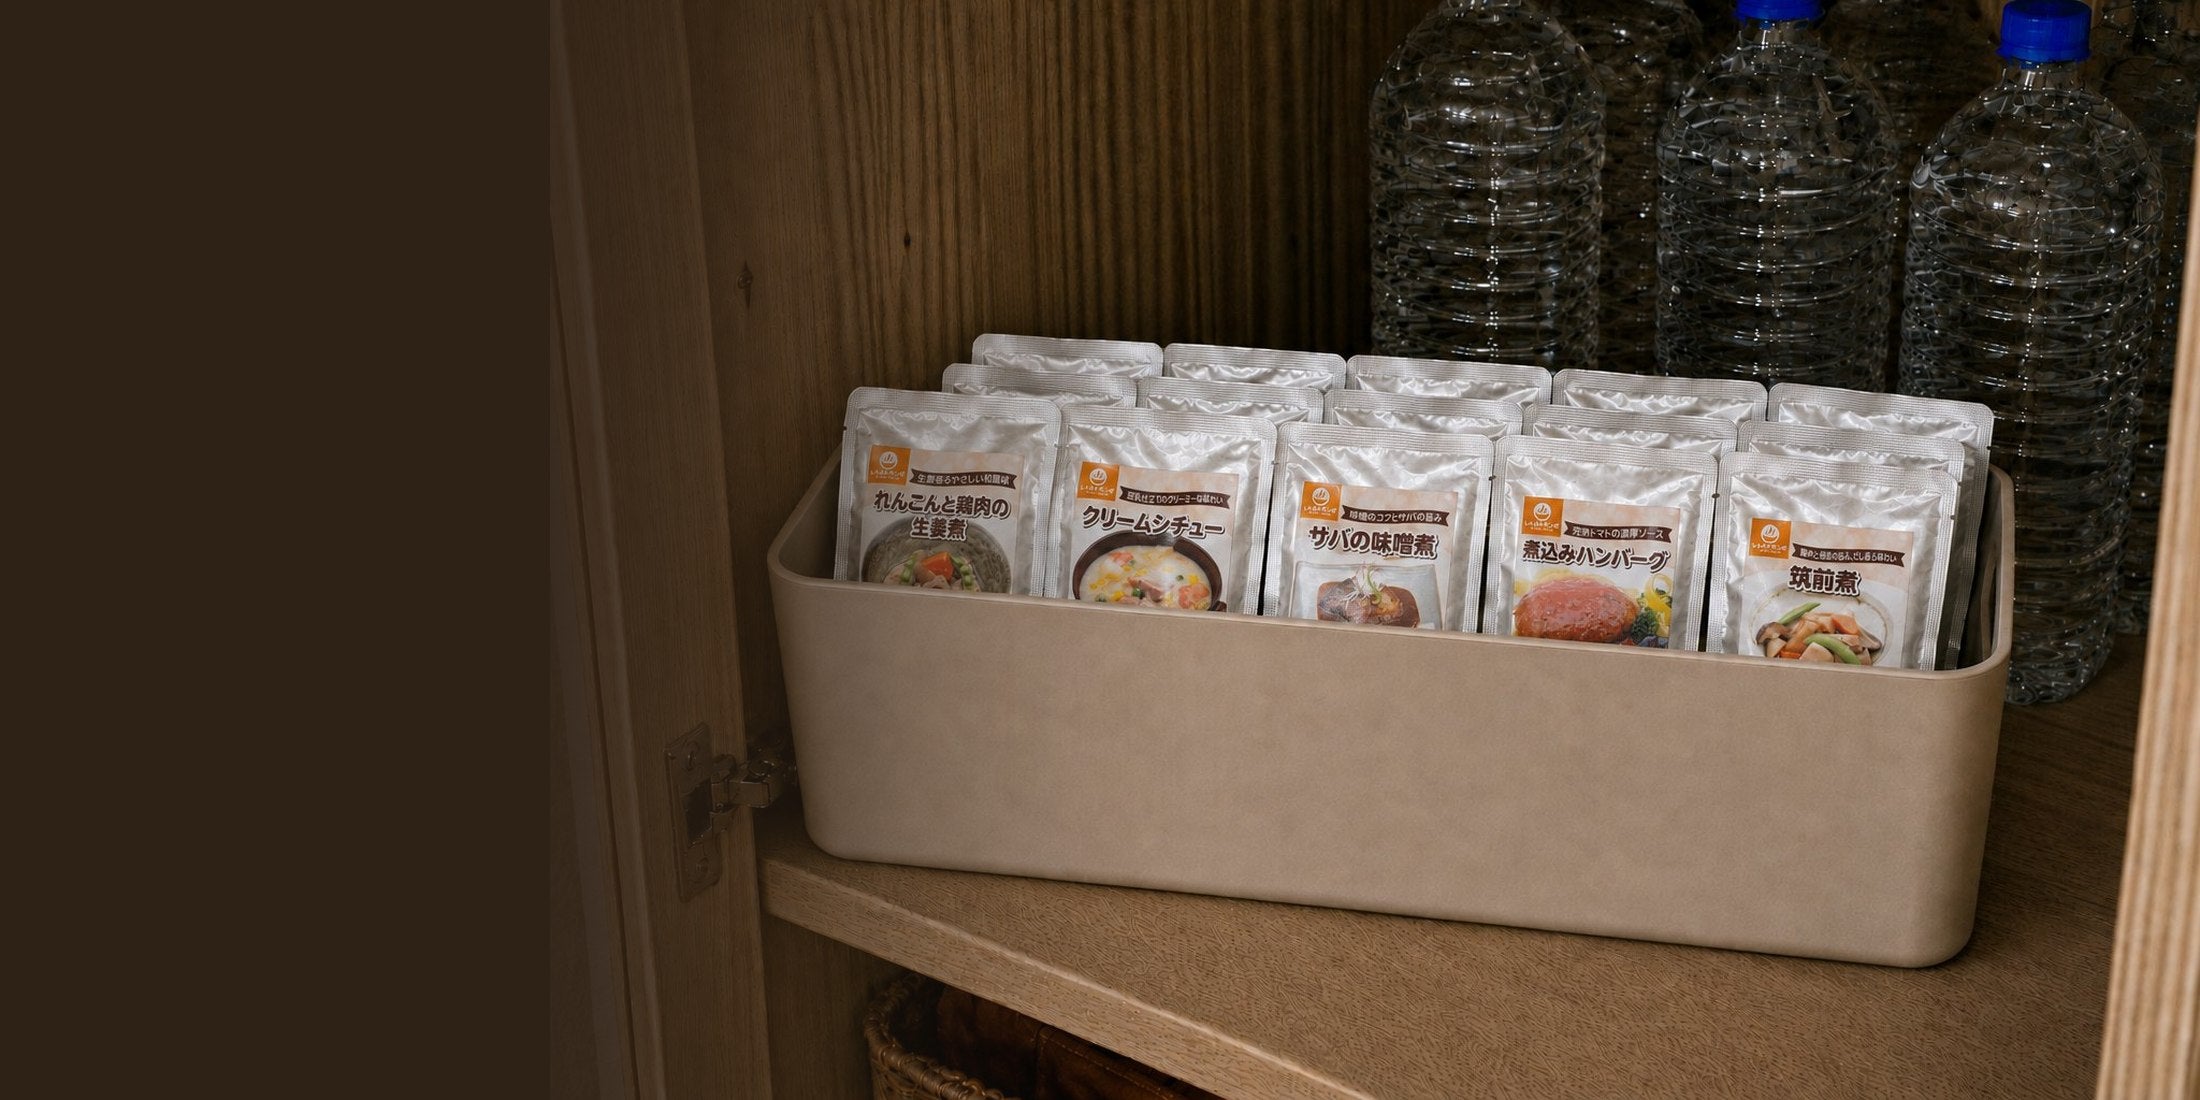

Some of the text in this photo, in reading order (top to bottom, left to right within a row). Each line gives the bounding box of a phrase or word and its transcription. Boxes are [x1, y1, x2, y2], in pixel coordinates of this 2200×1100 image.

[874, 490, 1010, 518] れんこんと鶏肉の
[911, 518, 967, 540] 生姜煮
[1083, 506, 1224, 537] クリームシチュー
[1572, 528, 1664, 539] 完熟トマトの濃厚ソース
[1309, 526, 1437, 558] サバの味噌煮
[1522, 540, 1671, 572] 煮込みハンバーグ
[1789, 565, 1860, 595] 筑前煮
